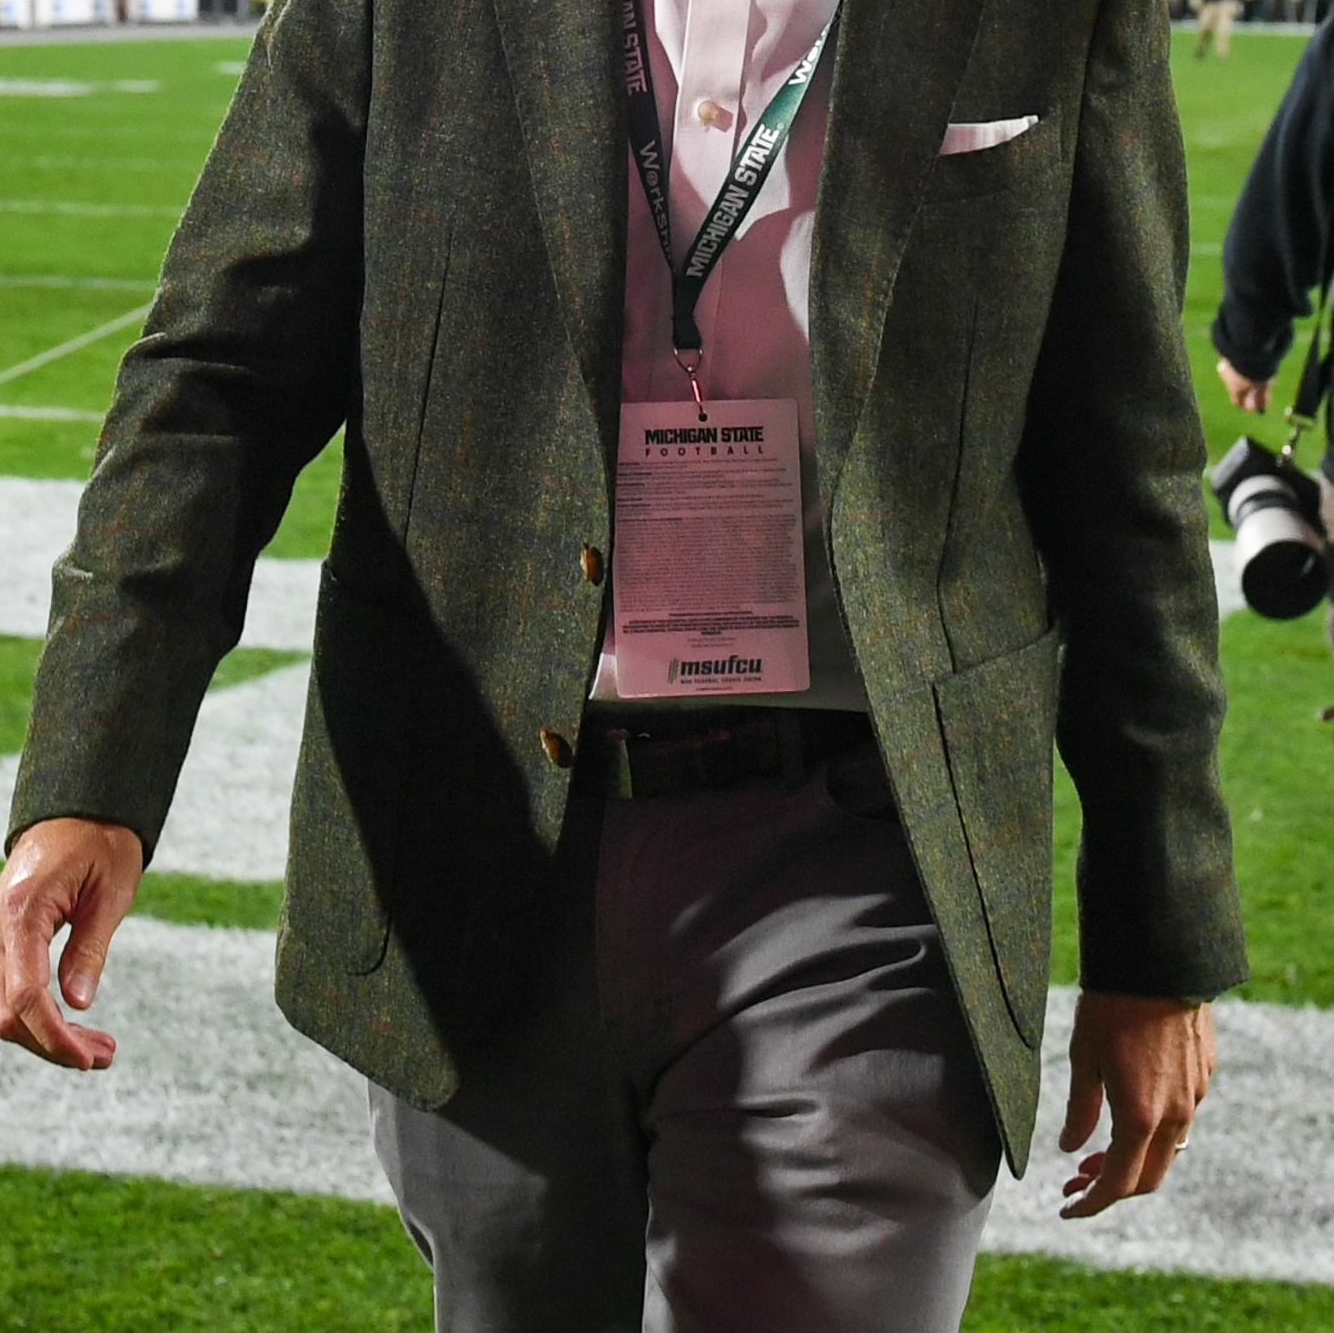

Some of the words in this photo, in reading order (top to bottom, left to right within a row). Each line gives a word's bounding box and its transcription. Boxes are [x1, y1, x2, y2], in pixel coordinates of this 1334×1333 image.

[686, 184, 749, 277] MICHIGAN
[734, 123, 780, 186] STATE
[645, 427, 717, 445] MICHIGAN
[721, 426, 764, 442] STATE
[645, 446, 764, 457] FOOTBALL
[680, 655, 763, 676] msufcu
